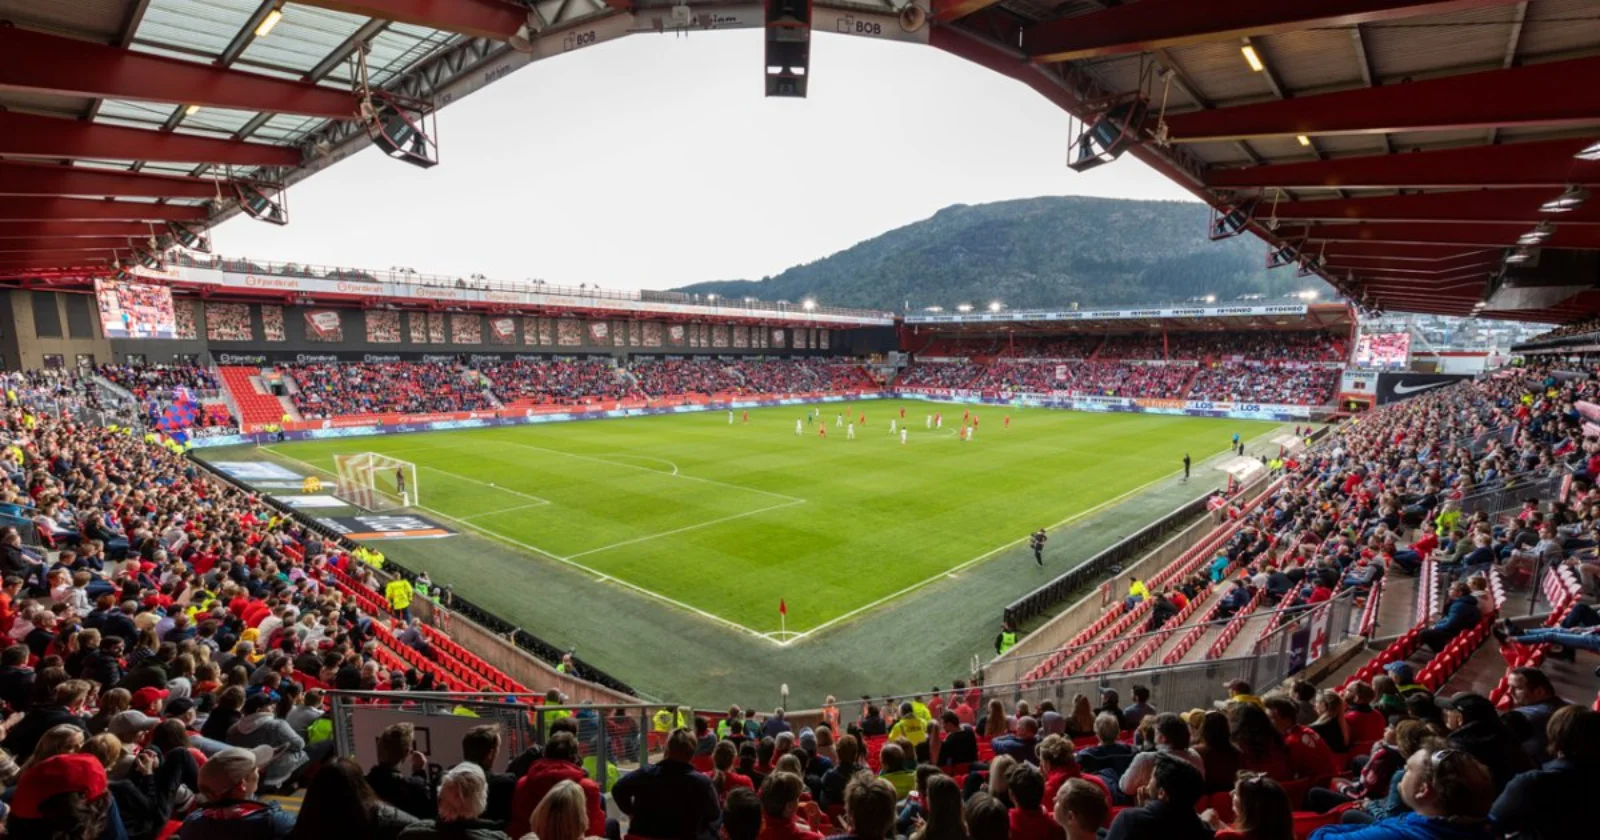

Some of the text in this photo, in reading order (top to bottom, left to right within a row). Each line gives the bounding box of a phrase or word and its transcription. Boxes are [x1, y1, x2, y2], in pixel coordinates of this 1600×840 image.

[856, 21, 882, 34] BOB
[577, 31, 596, 45] BOB
[256, 278, 299, 289] Fjordkraft
[1240, 404, 1260, 412] LOS
